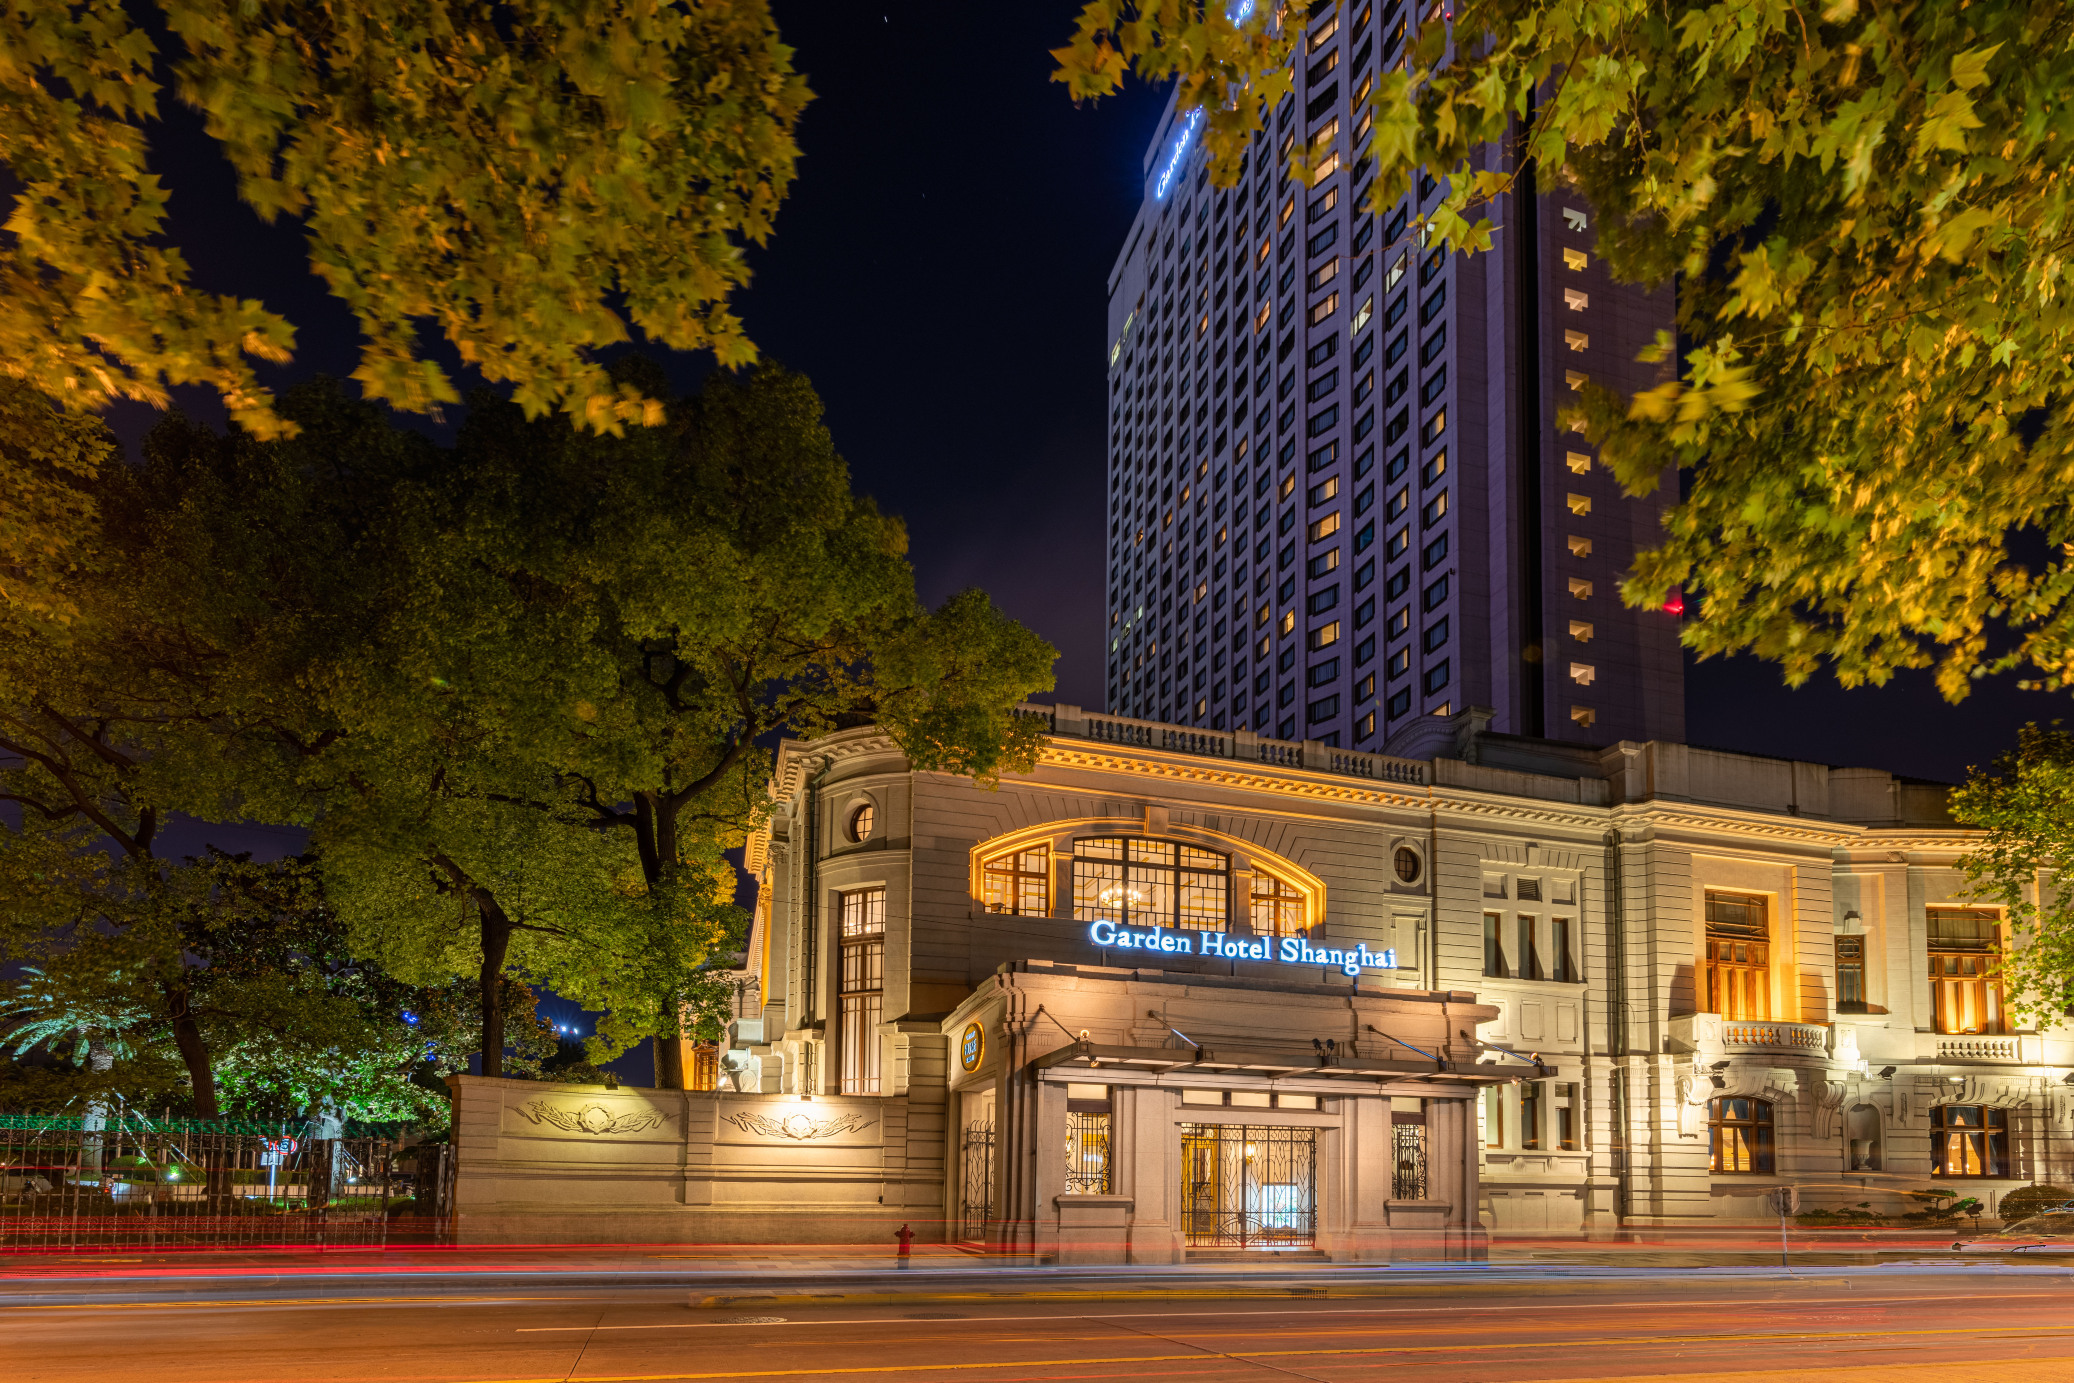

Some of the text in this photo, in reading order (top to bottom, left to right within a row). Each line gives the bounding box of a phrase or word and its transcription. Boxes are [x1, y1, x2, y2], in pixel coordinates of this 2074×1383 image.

[1090, 920, 1397, 975] Garden Hotel Shanghai
